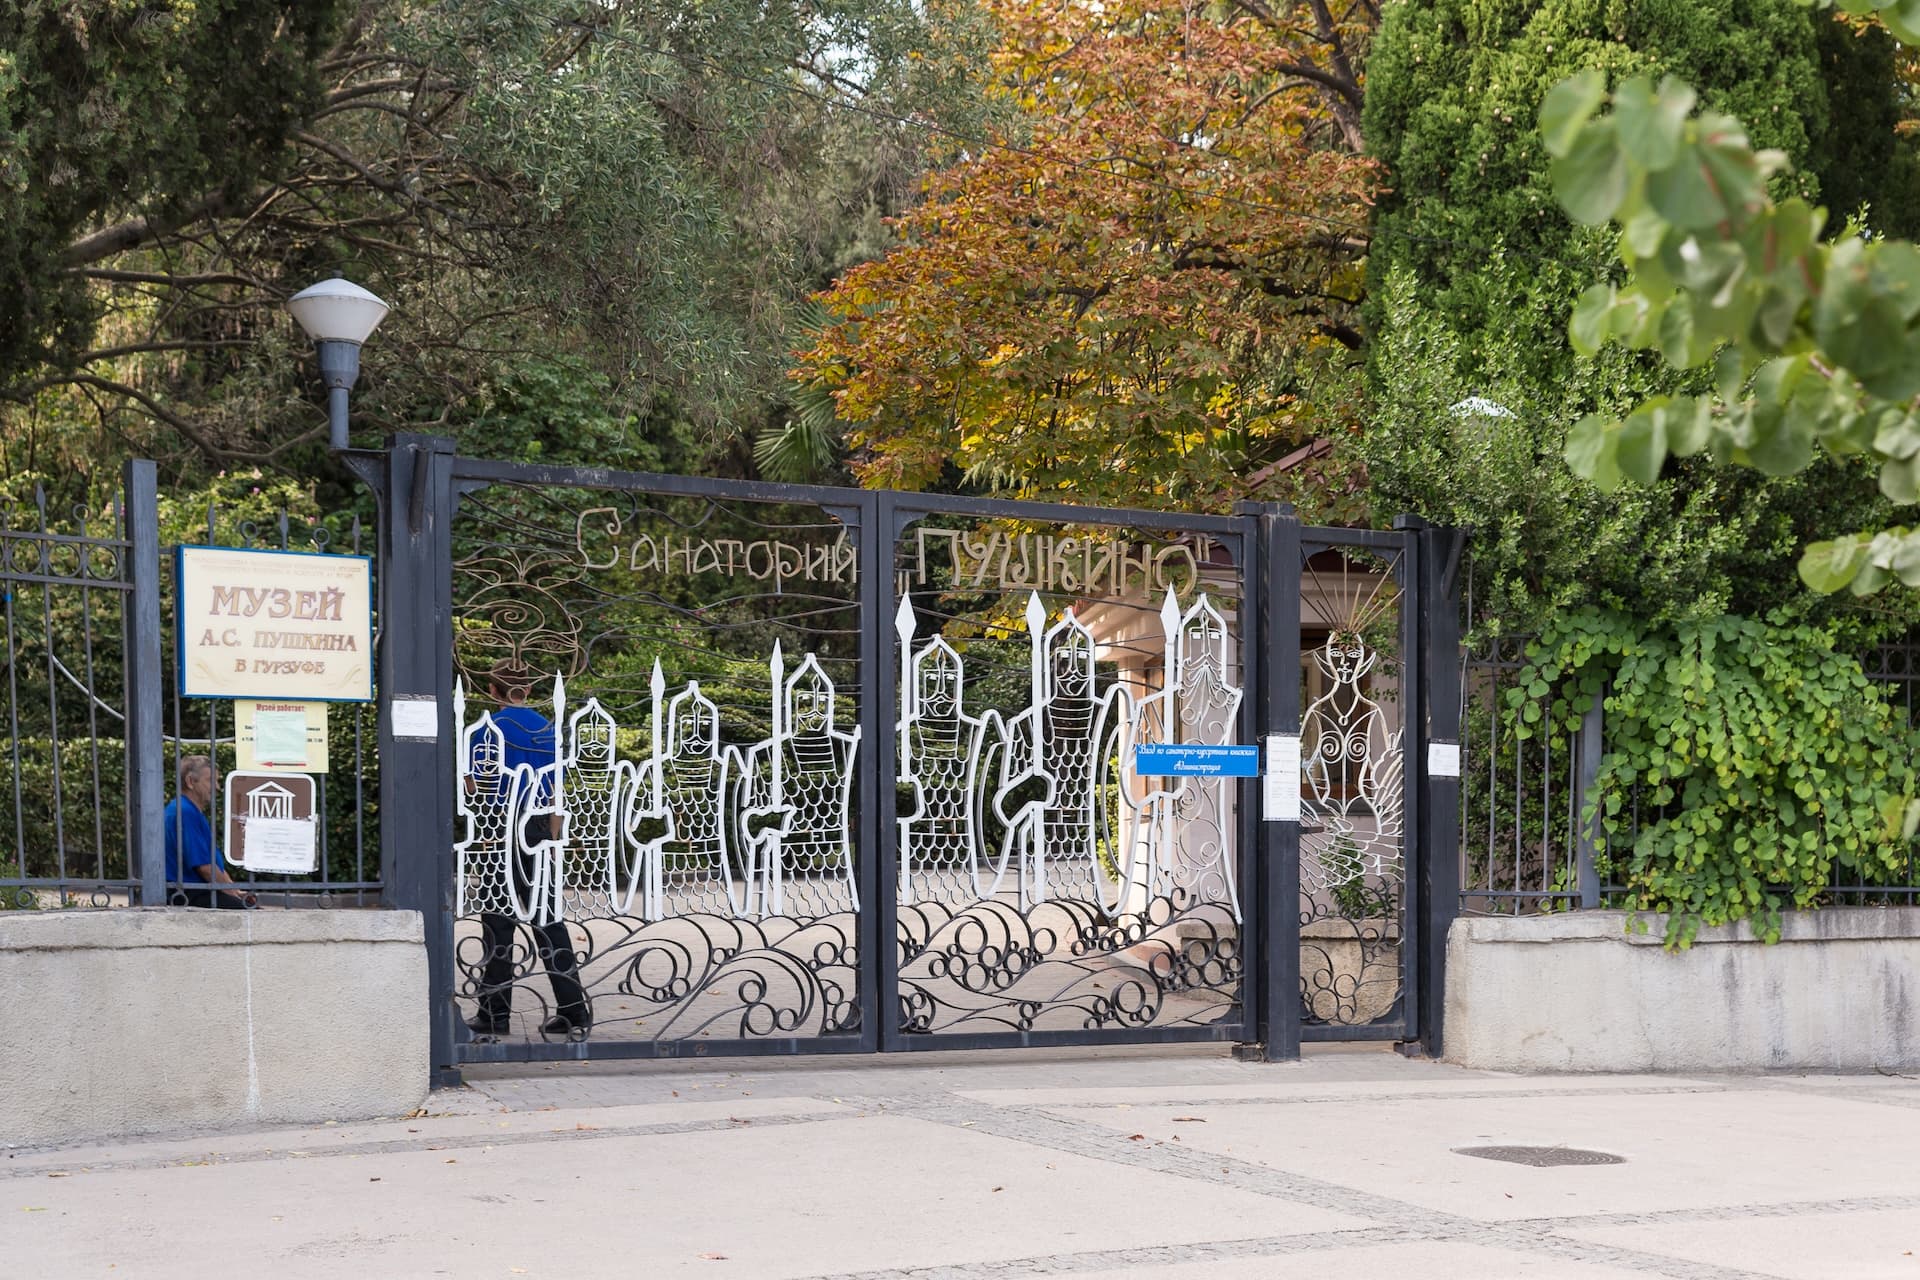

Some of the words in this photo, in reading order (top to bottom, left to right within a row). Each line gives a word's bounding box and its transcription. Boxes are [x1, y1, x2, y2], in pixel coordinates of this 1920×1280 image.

[577, 507, 857, 594] Санаторий
[209, 585, 345, 622] МУЗЕЙ
[200, 628, 242, 647] А.С.
[253, 630, 357, 652] ПУШКИНА
[234, 658, 246, 673] В
[252, 659, 325, 675] ГУРЗУФЕ
[256, 703, 275, 711] Музей
